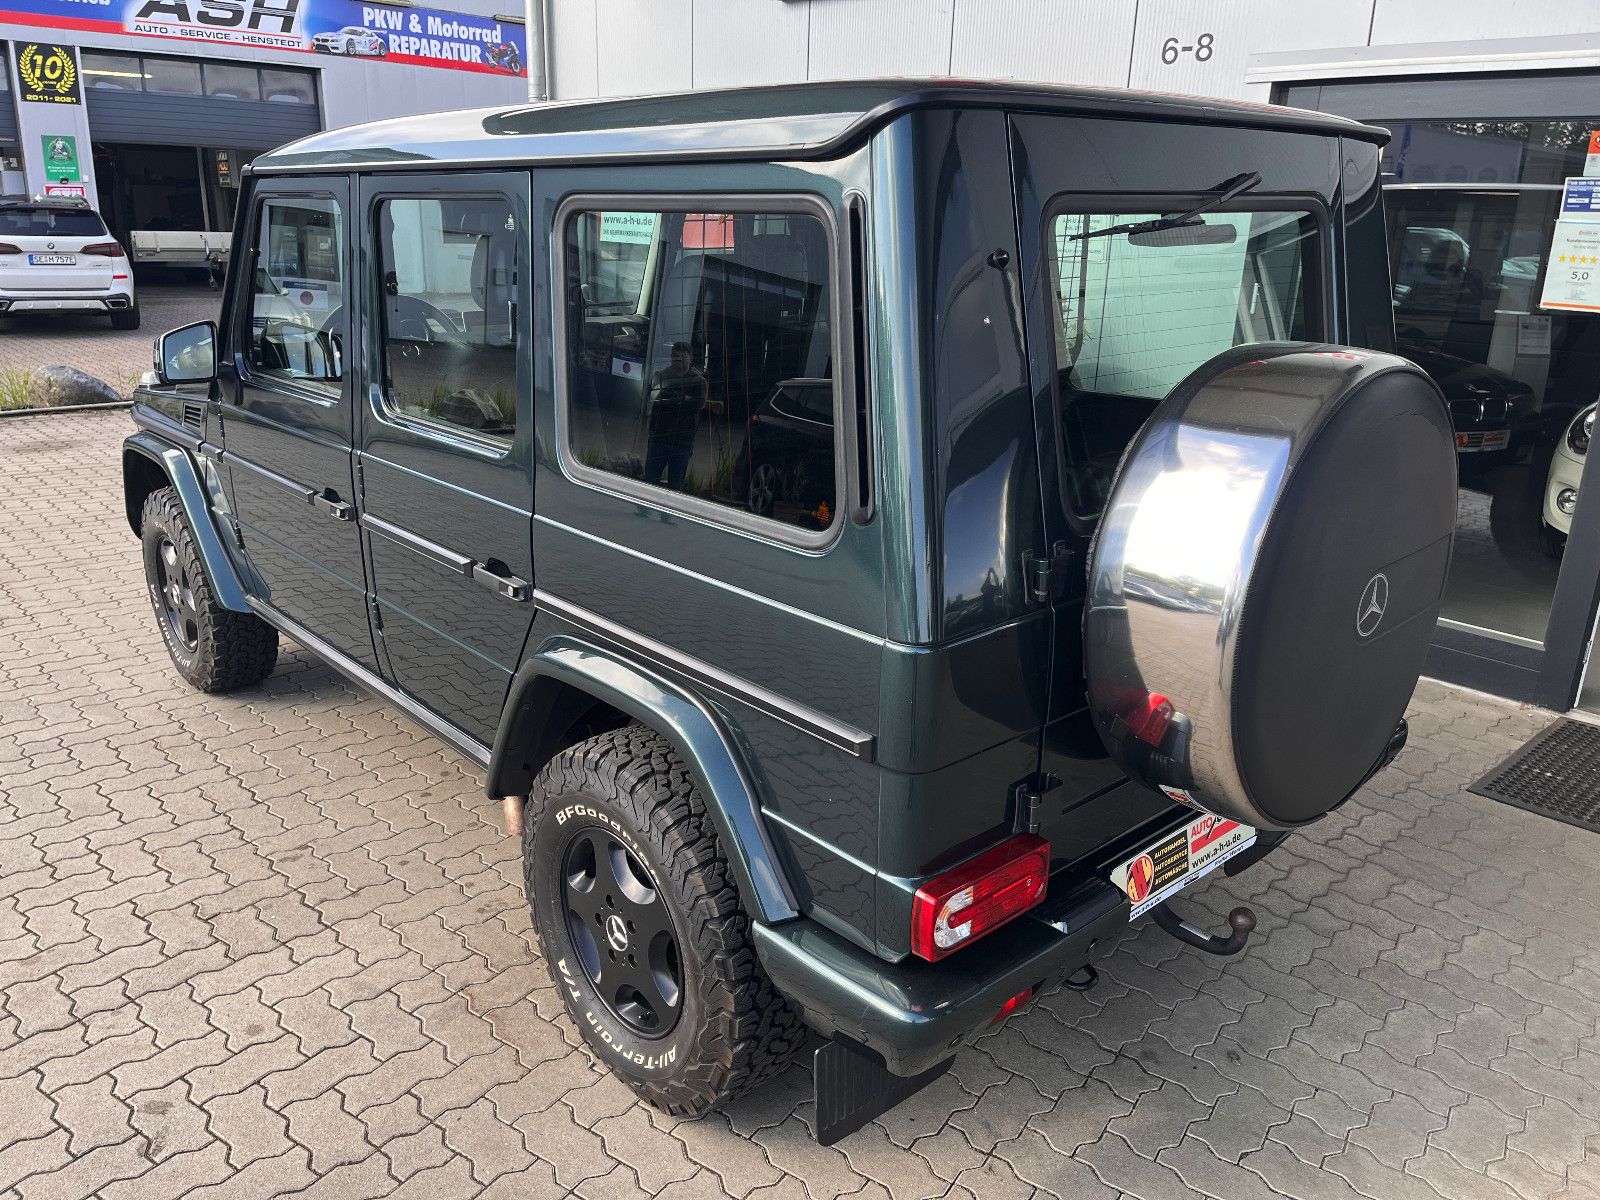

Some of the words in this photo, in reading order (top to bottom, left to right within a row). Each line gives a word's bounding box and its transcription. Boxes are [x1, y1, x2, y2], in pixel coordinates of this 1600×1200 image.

[135, 0, 299, 33] ASH
[362, 7, 404, 31] PKW
[409, 13, 423, 34] &
[428, 15, 502, 44] Motorrad
[135, 24, 168, 34] AUTO
[180, 28, 231, 40] SERVICE
[242, 34, 302, 48] HENSTEDT
[388, 33, 483, 64] REPARATUR
[1161, 32, 1214, 65] 6-8
[33, 54, 63, 79] 10
[603, 215, 653, 225] www.a-h-u.de
[1571, 271, 1589, 281] 5,0
[1154, 837, 1187, 859] AUTOHANDEL
[1154, 848, 1188, 873] AUTOSERVICE
[1192, 833, 1241, 868] www.a-h-u.de
[558, 959, 581, 1002] T/A
[586, 1011, 676, 1069] All-Terrain
